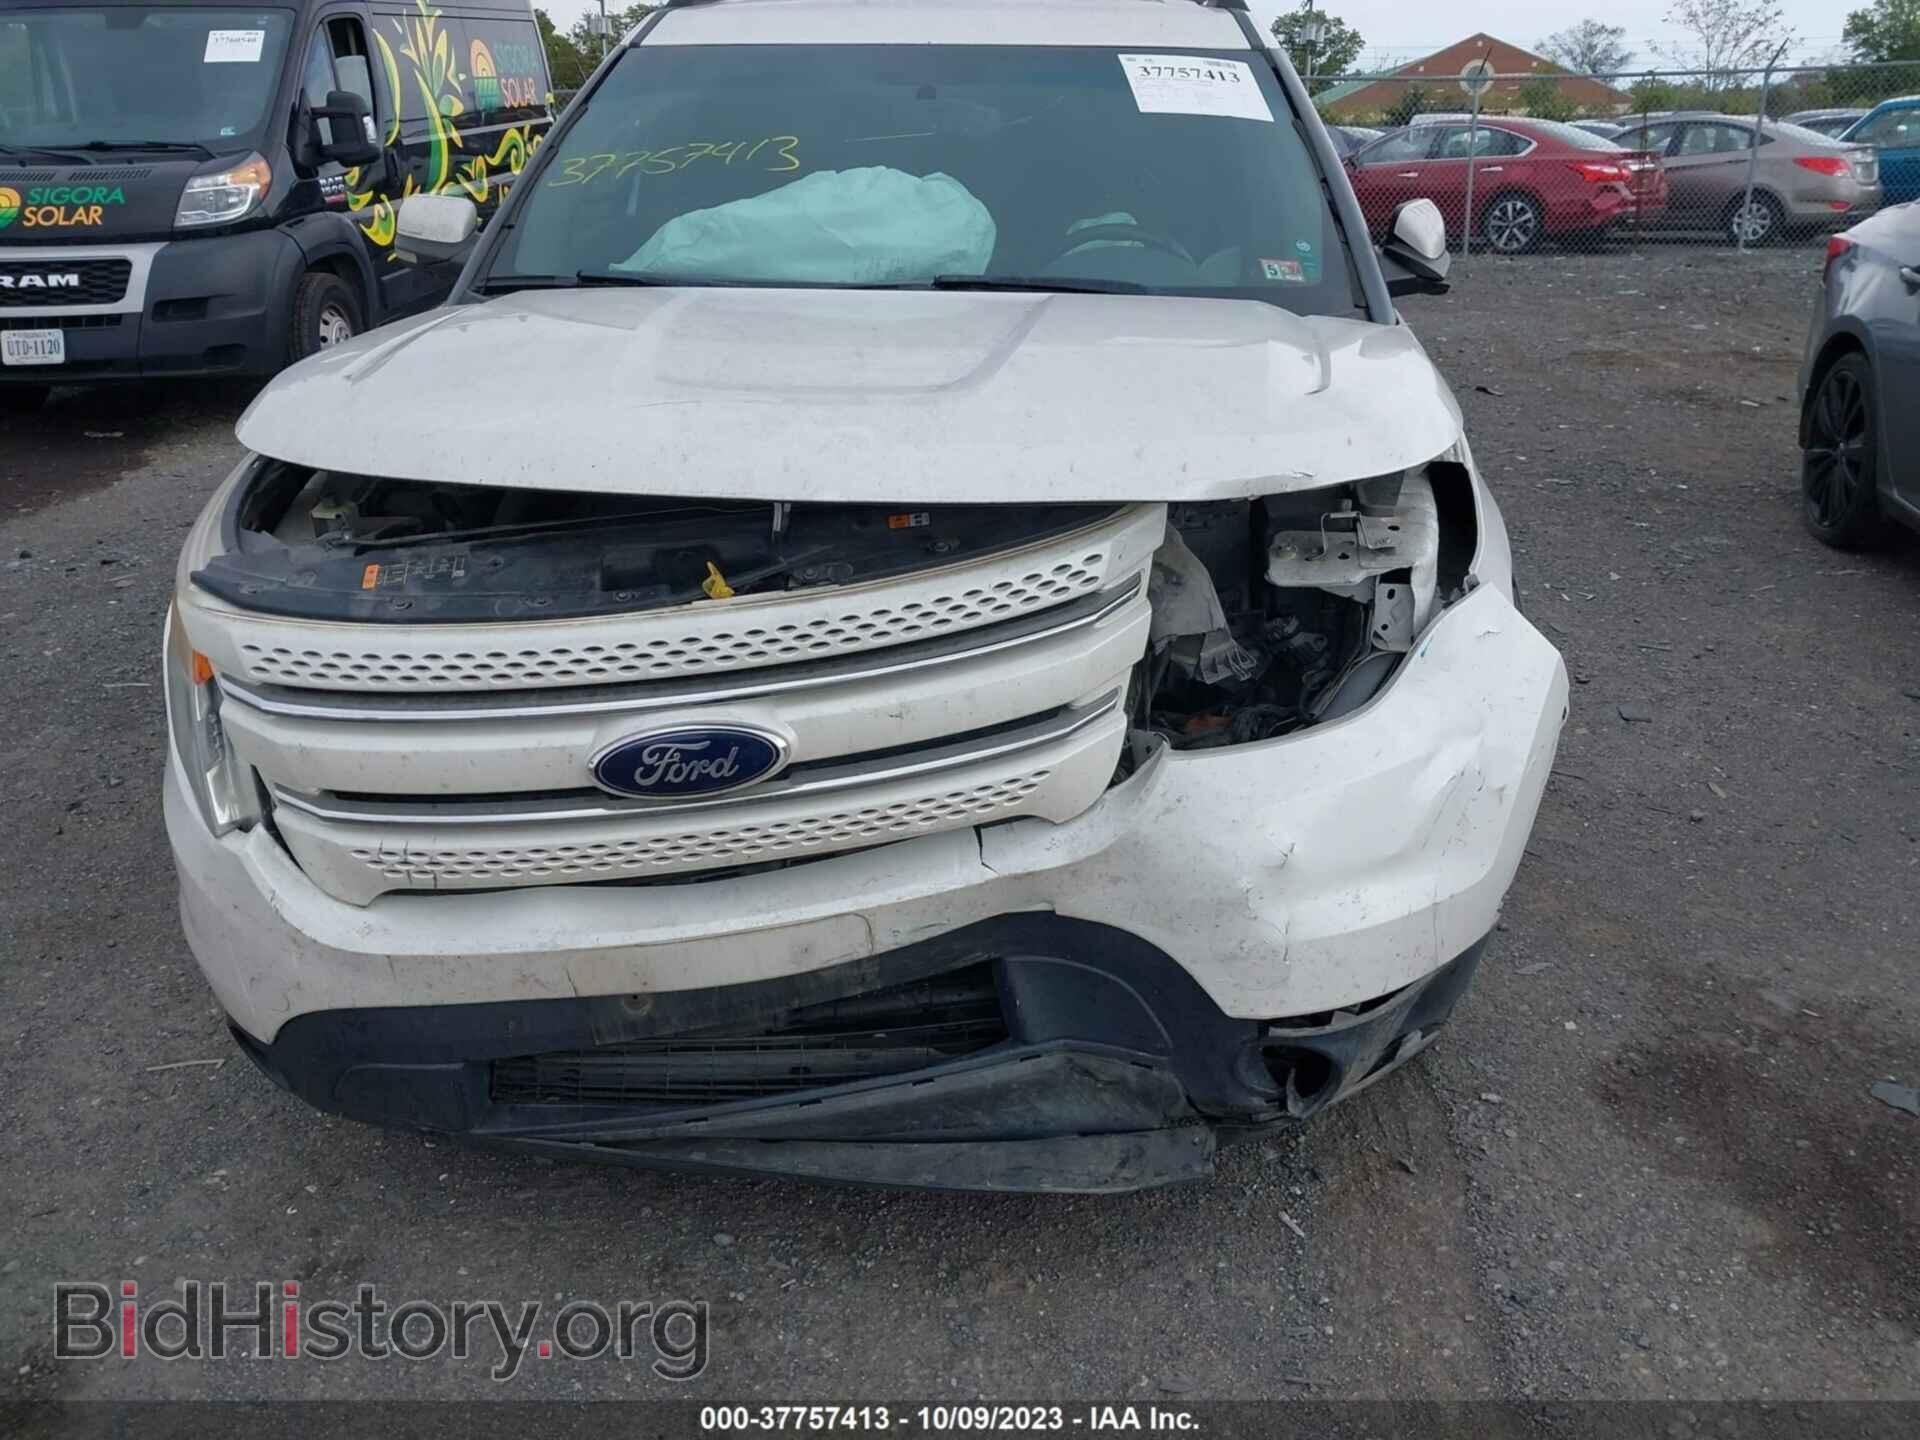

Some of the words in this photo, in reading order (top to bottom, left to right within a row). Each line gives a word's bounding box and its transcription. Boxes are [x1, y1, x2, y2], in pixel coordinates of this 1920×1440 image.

[1138, 65, 1240, 83] 37757413
[501, 78, 538, 108] SOLAR
[547, 135, 800, 187] 37757413
[28, 186, 125, 205] SIGORA
[22, 205, 104, 227] SOLAR
[0, 273, 79, 288] RAM
[633, 740, 739, 786] Ford
